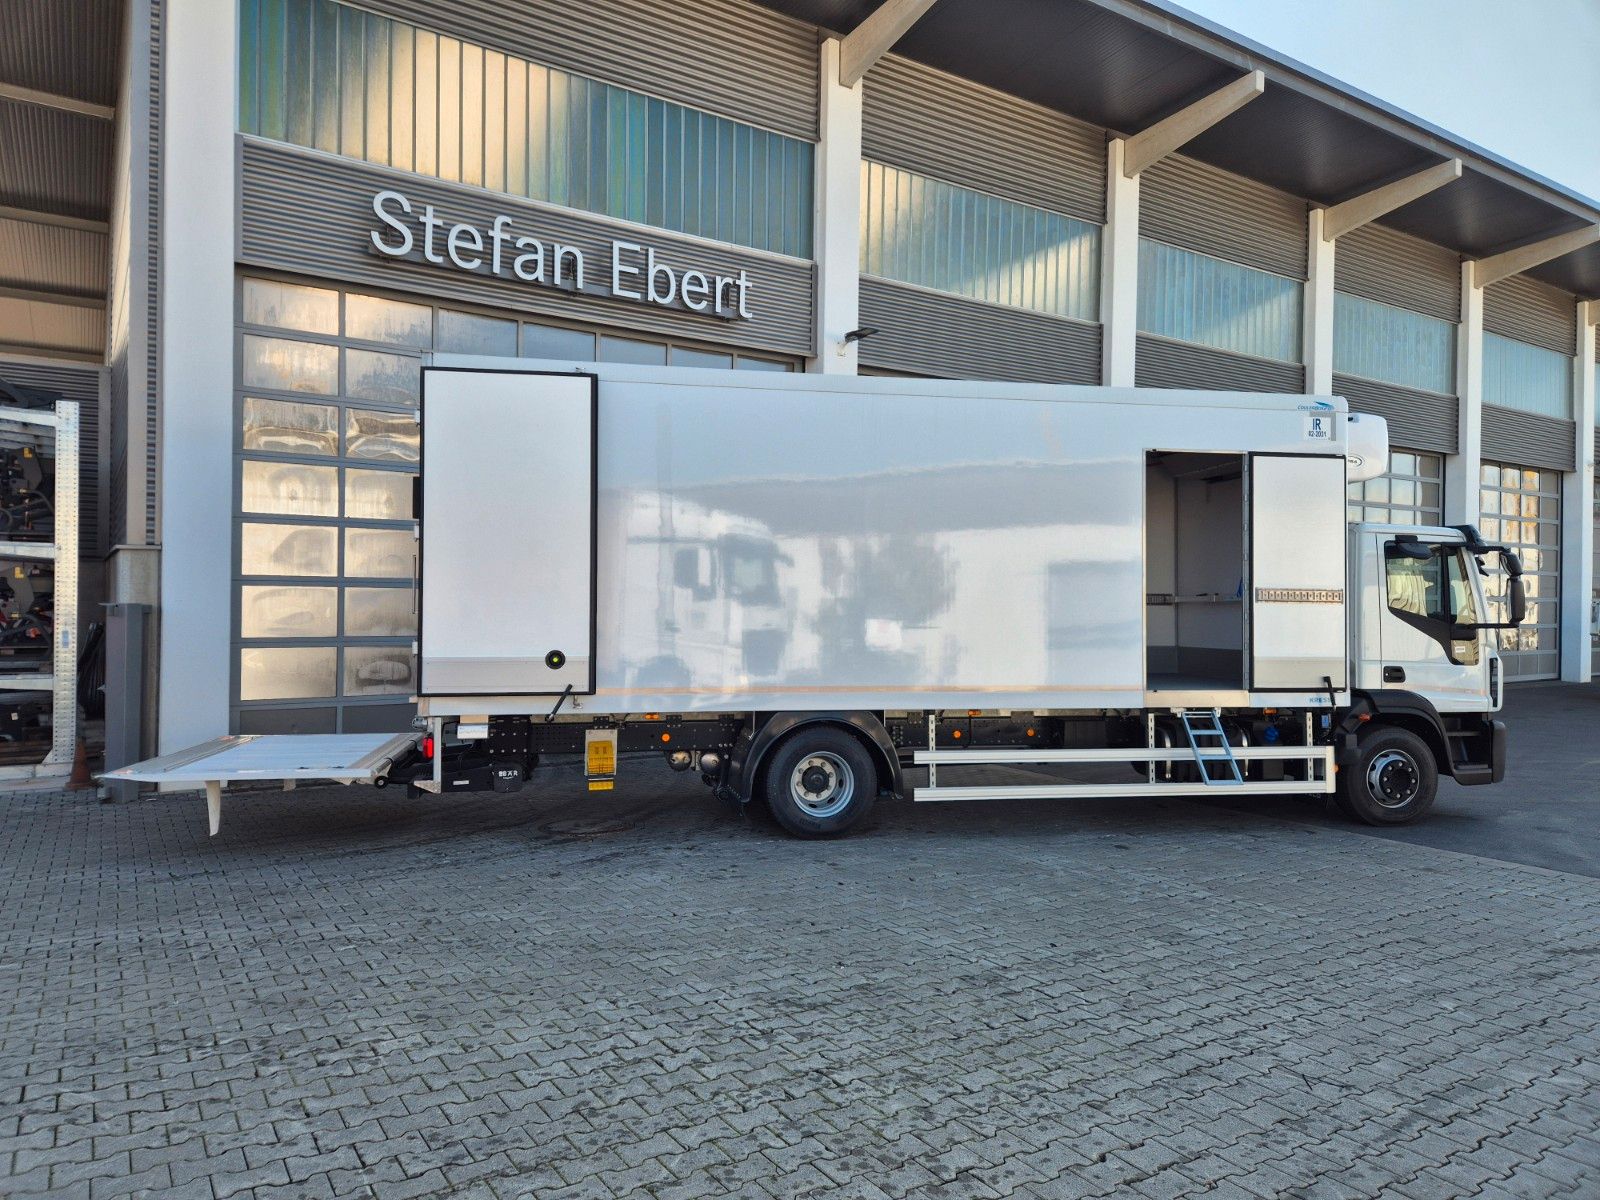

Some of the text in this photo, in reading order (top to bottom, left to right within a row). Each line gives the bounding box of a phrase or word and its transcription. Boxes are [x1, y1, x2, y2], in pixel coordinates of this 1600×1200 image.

[370, 190, 753, 320] Stefan Ebert
[1312, 418, 1321, 430] IR
